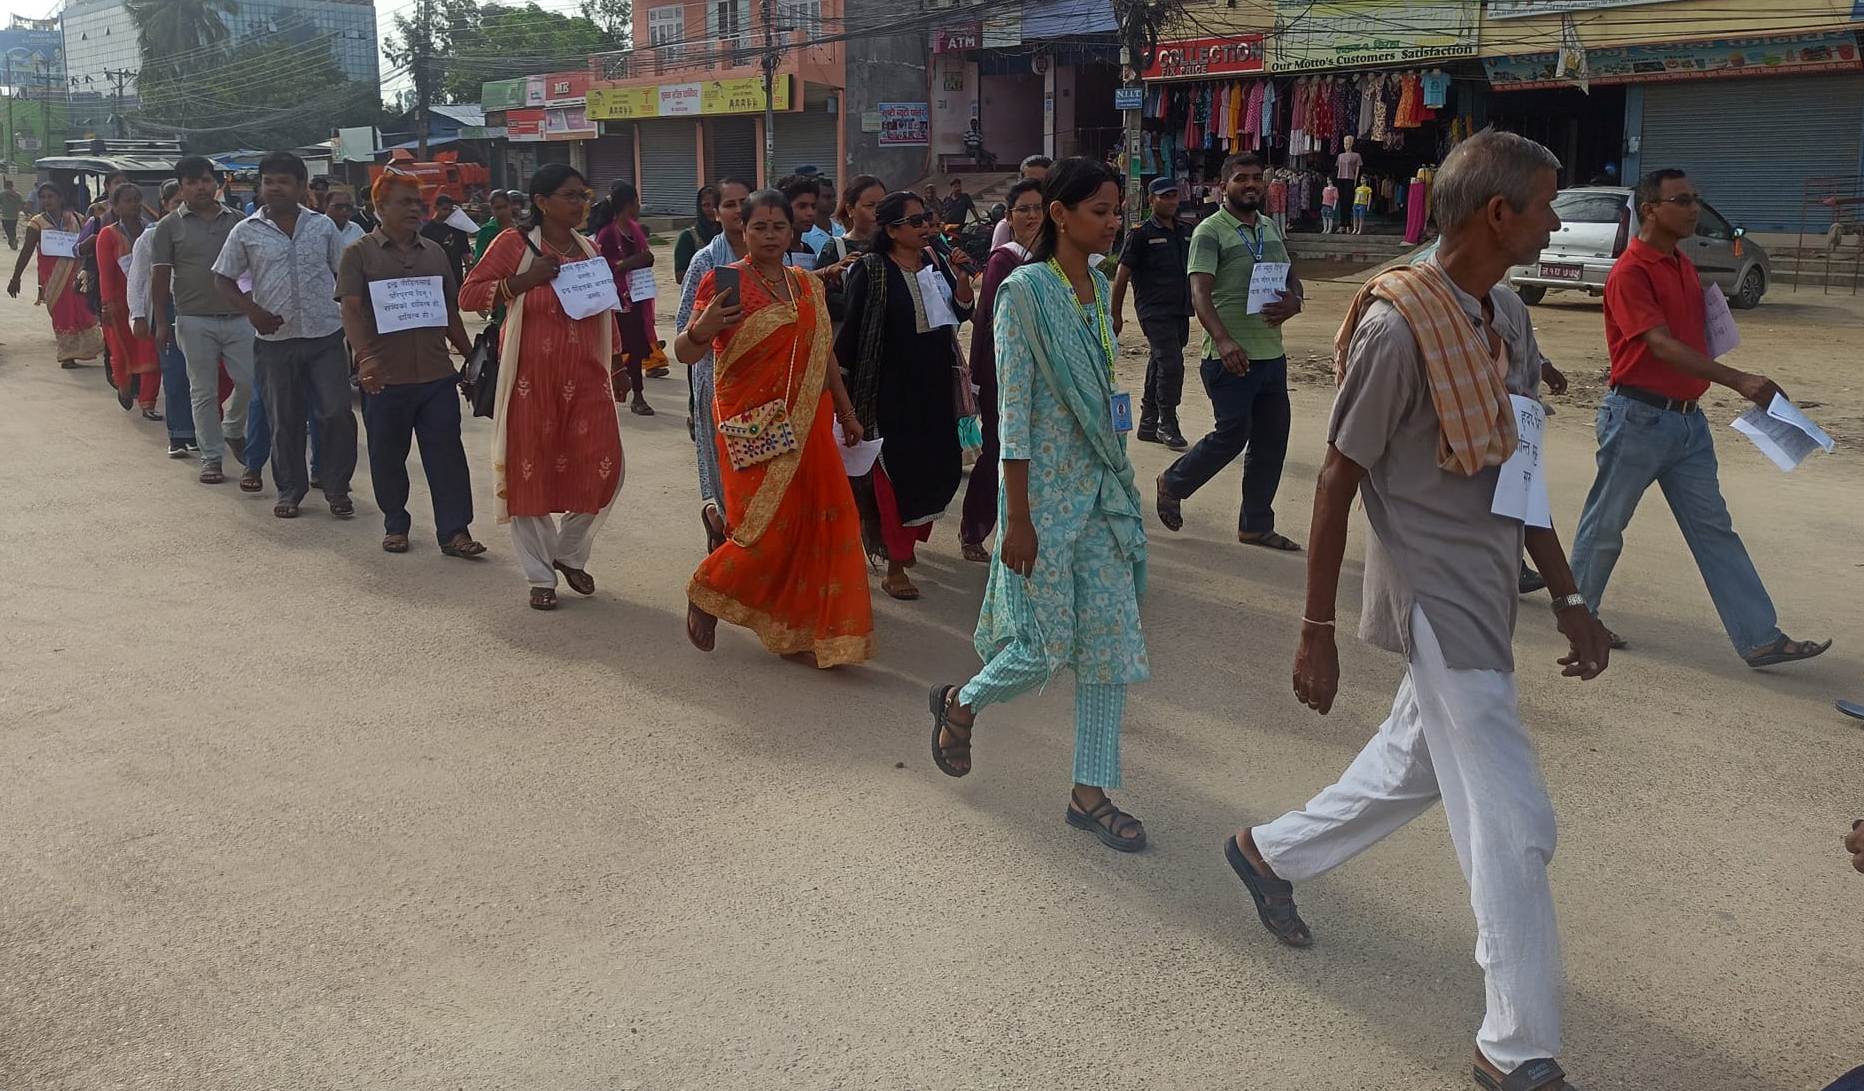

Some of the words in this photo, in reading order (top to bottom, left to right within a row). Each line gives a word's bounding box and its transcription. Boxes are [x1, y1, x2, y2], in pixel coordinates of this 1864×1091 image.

[947, 36, 976, 49] ATM
[1158, 41, 1264, 68] COLLECTION
[1271, 61, 1292, 72] Our
[1294, 56, 1334, 69] Motto's
[1336, 53, 1396, 65] Customers
[1401, 45, 1473, 60] Satisfaction
[1161, 67, 1176, 77] FIX
[1180, 64, 1208, 75] PRICE
